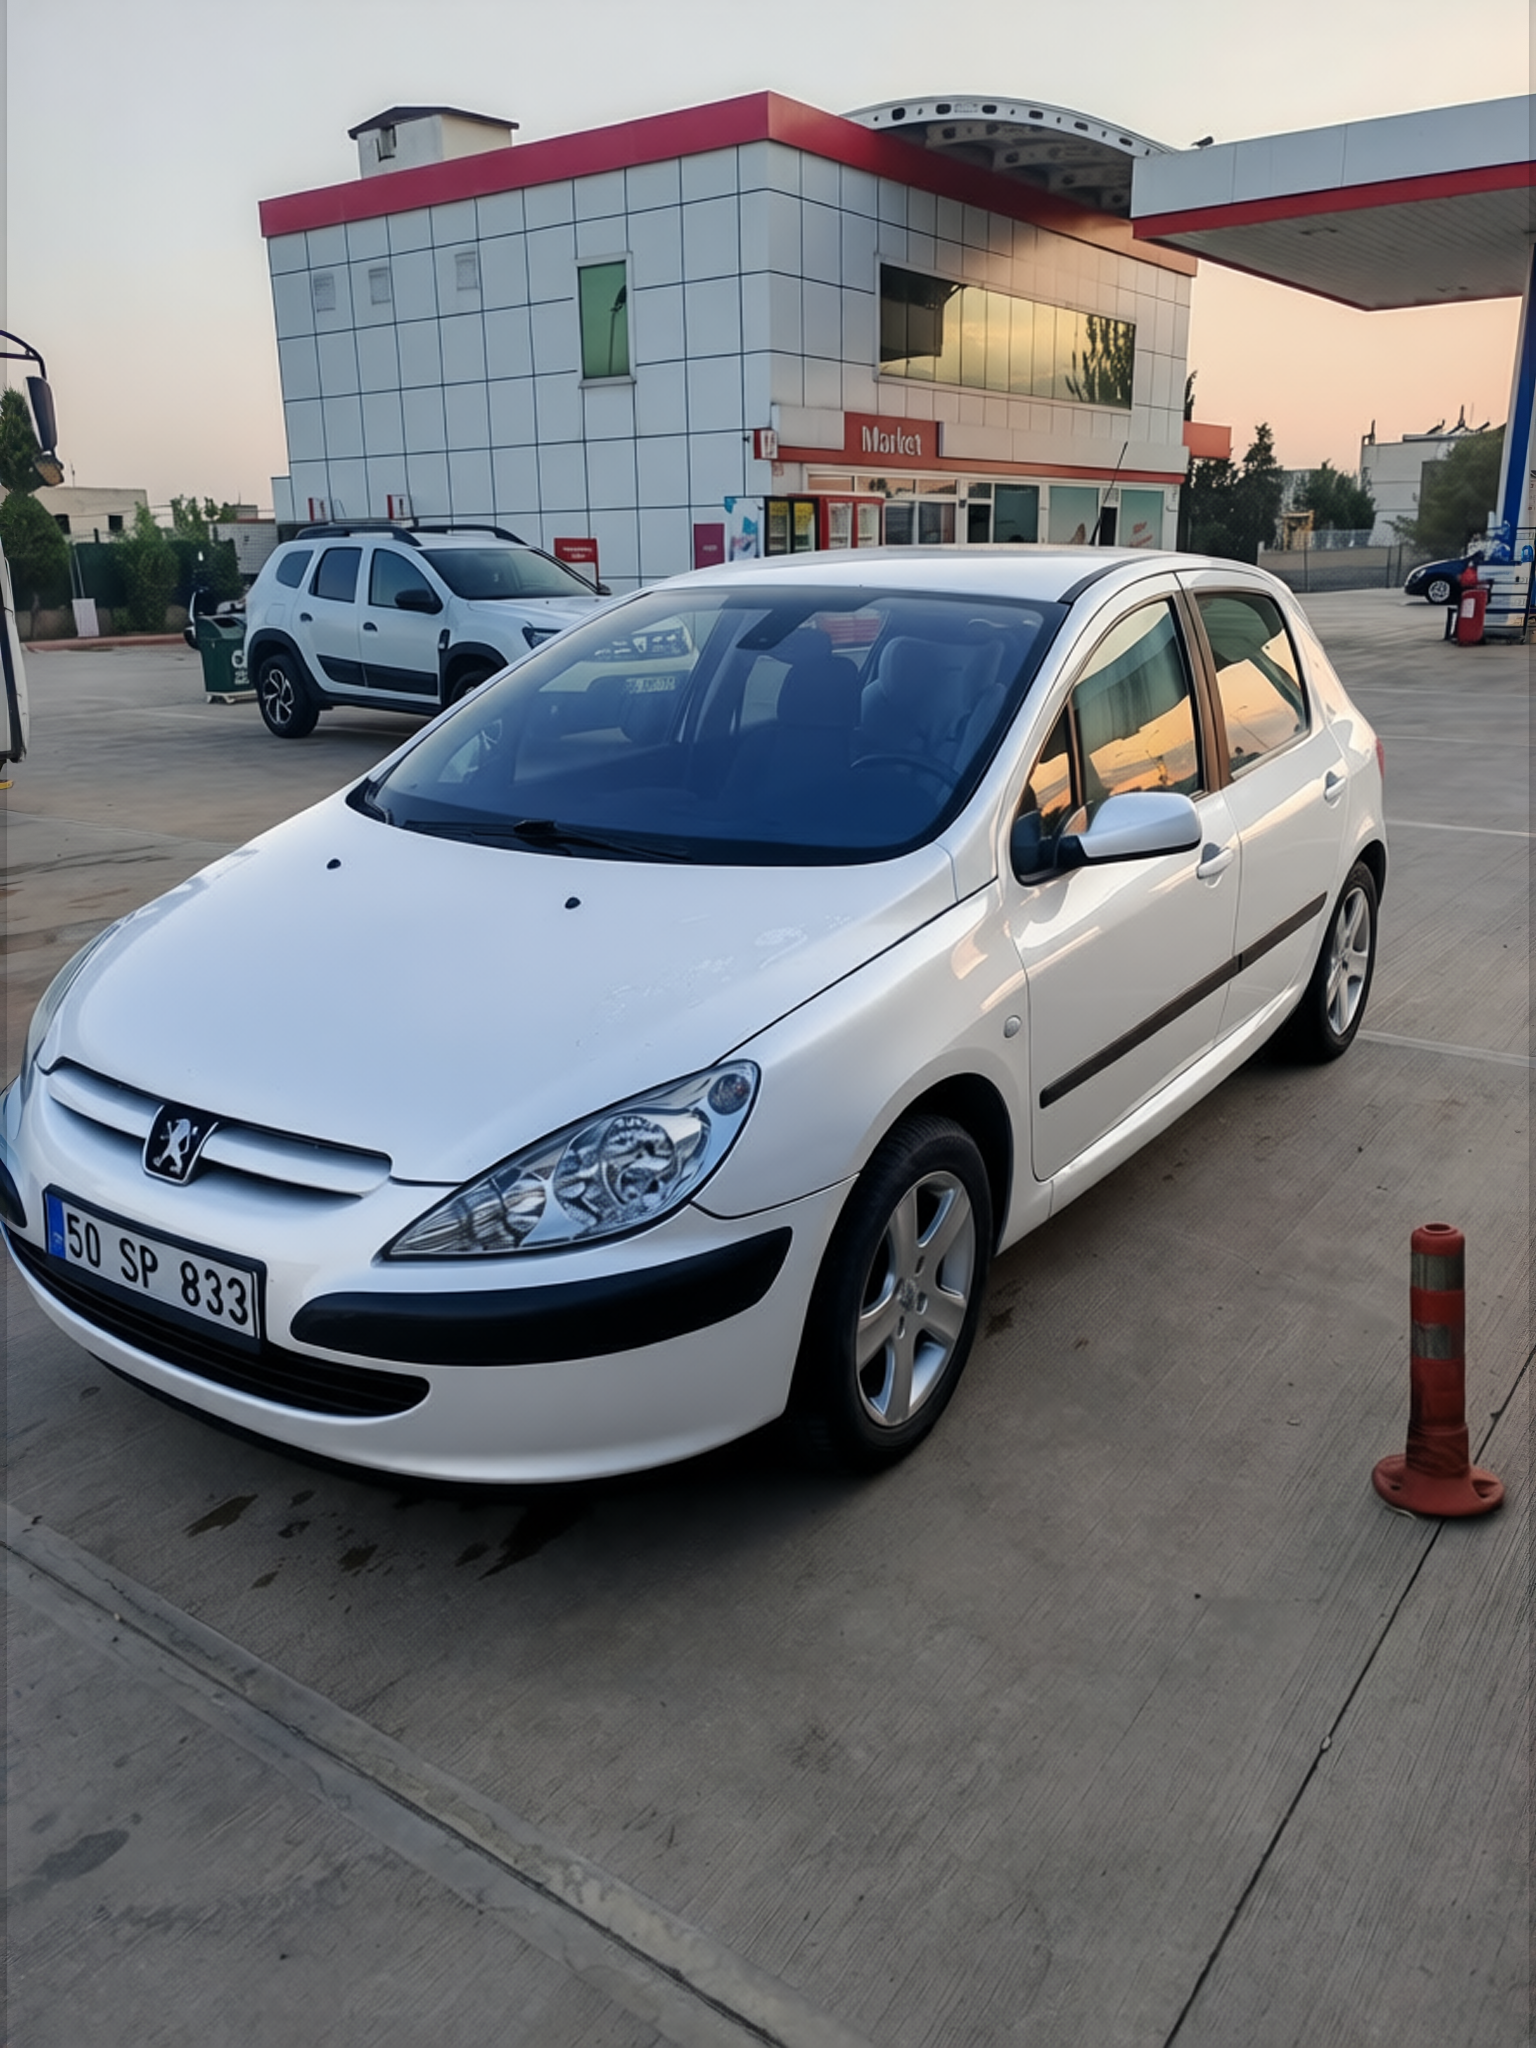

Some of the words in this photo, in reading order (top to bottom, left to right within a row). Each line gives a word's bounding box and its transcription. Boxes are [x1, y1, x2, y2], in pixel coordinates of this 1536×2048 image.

[862, 425, 921, 456] Market
[66, 1211, 101, 1268] 50
[119, 1237, 159, 1289] SP
[180, 1260, 248, 1326] 833
